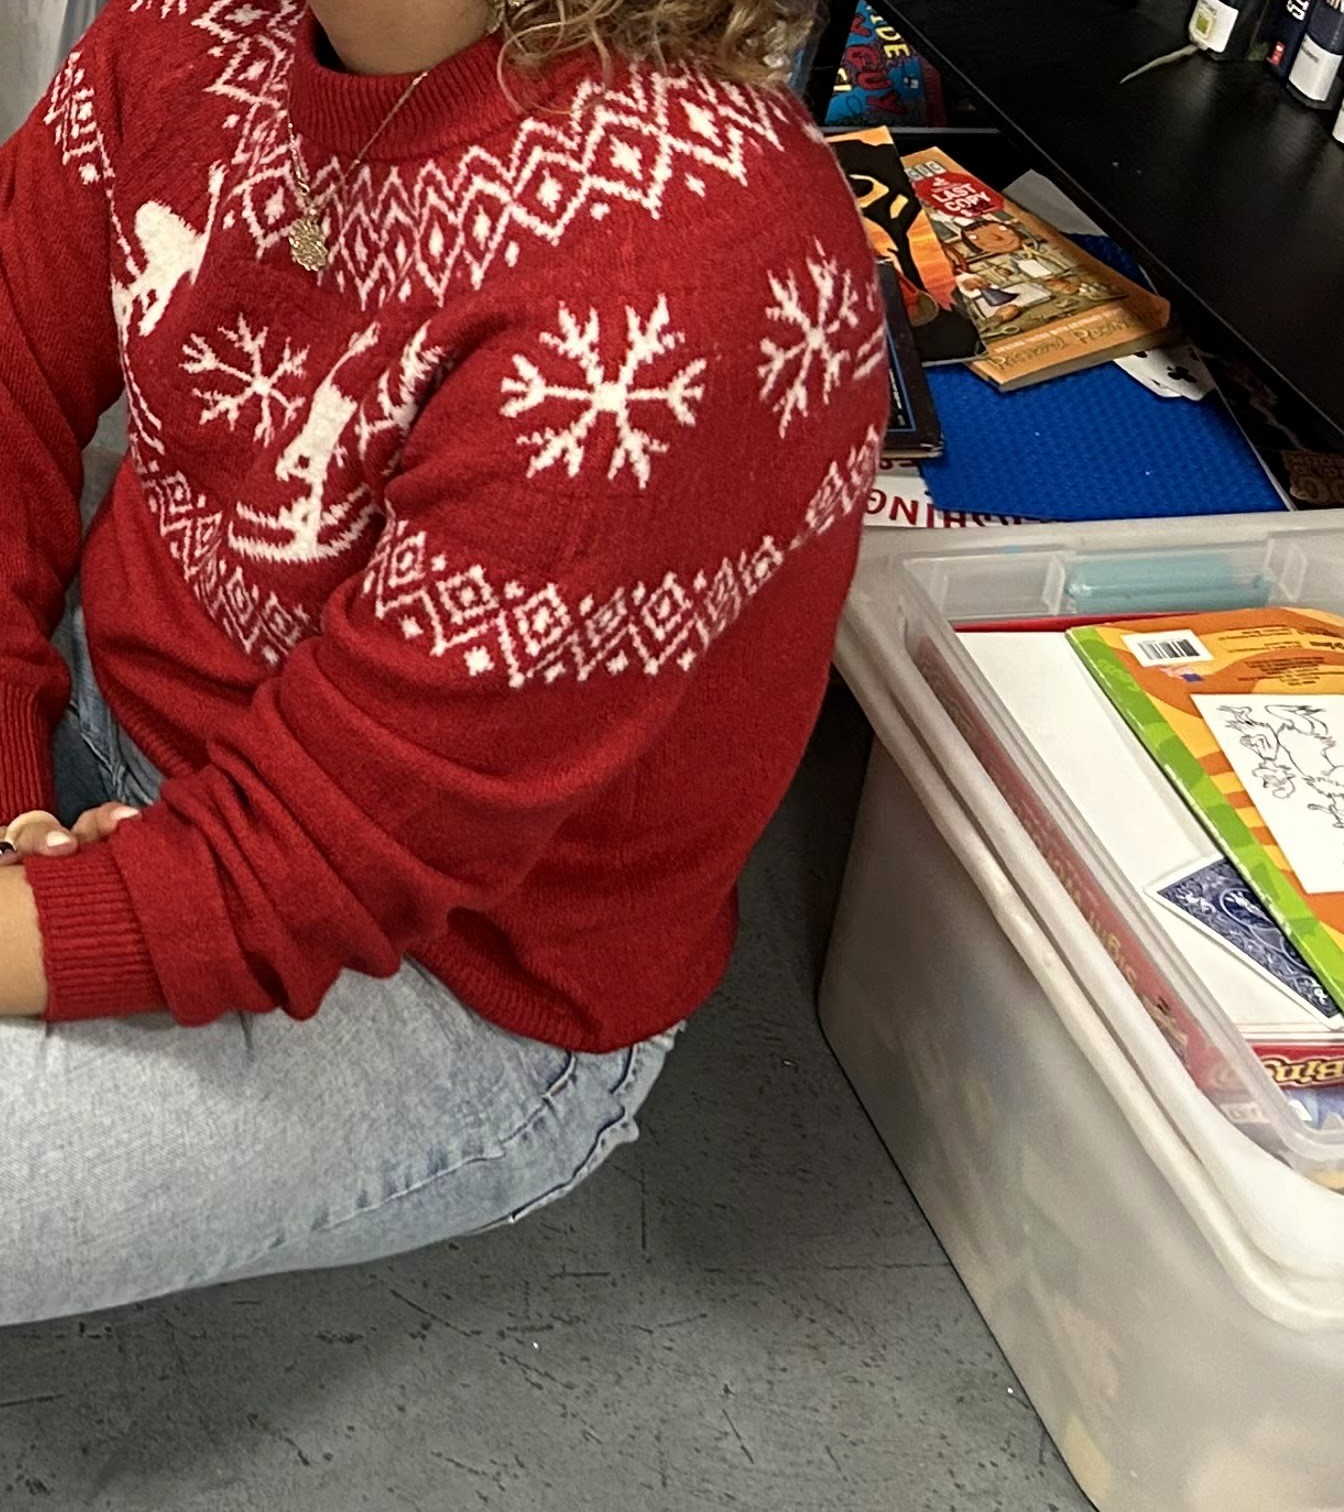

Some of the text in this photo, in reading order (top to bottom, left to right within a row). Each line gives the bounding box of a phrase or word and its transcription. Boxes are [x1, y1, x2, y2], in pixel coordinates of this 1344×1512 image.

[845, 45, 907, 115] GUY
[932, 181, 975, 203] LAST
[945, 191, 992, 212] COPY
